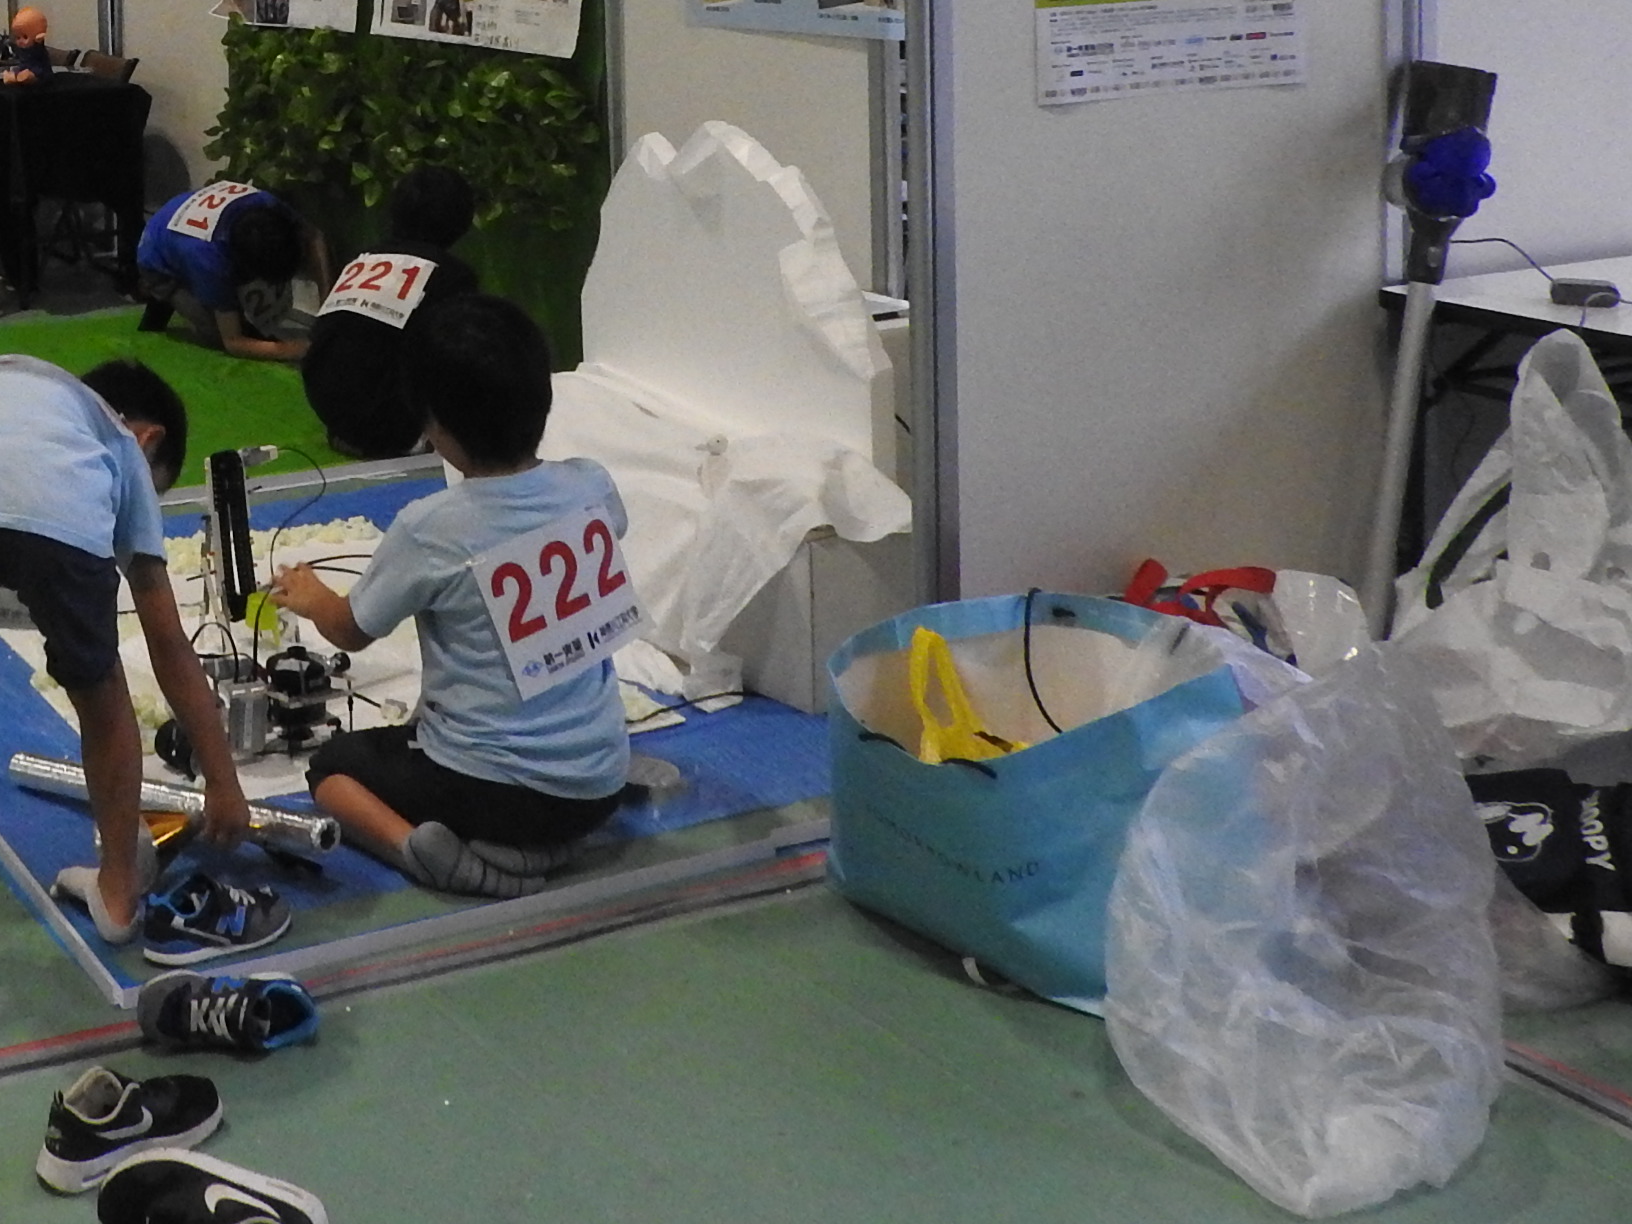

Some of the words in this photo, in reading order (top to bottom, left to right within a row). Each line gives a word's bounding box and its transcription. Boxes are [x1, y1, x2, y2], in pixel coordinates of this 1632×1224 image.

[186, 184, 249, 231] 221
[334, 261, 421, 301] 221
[490, 518, 627, 643] 222
